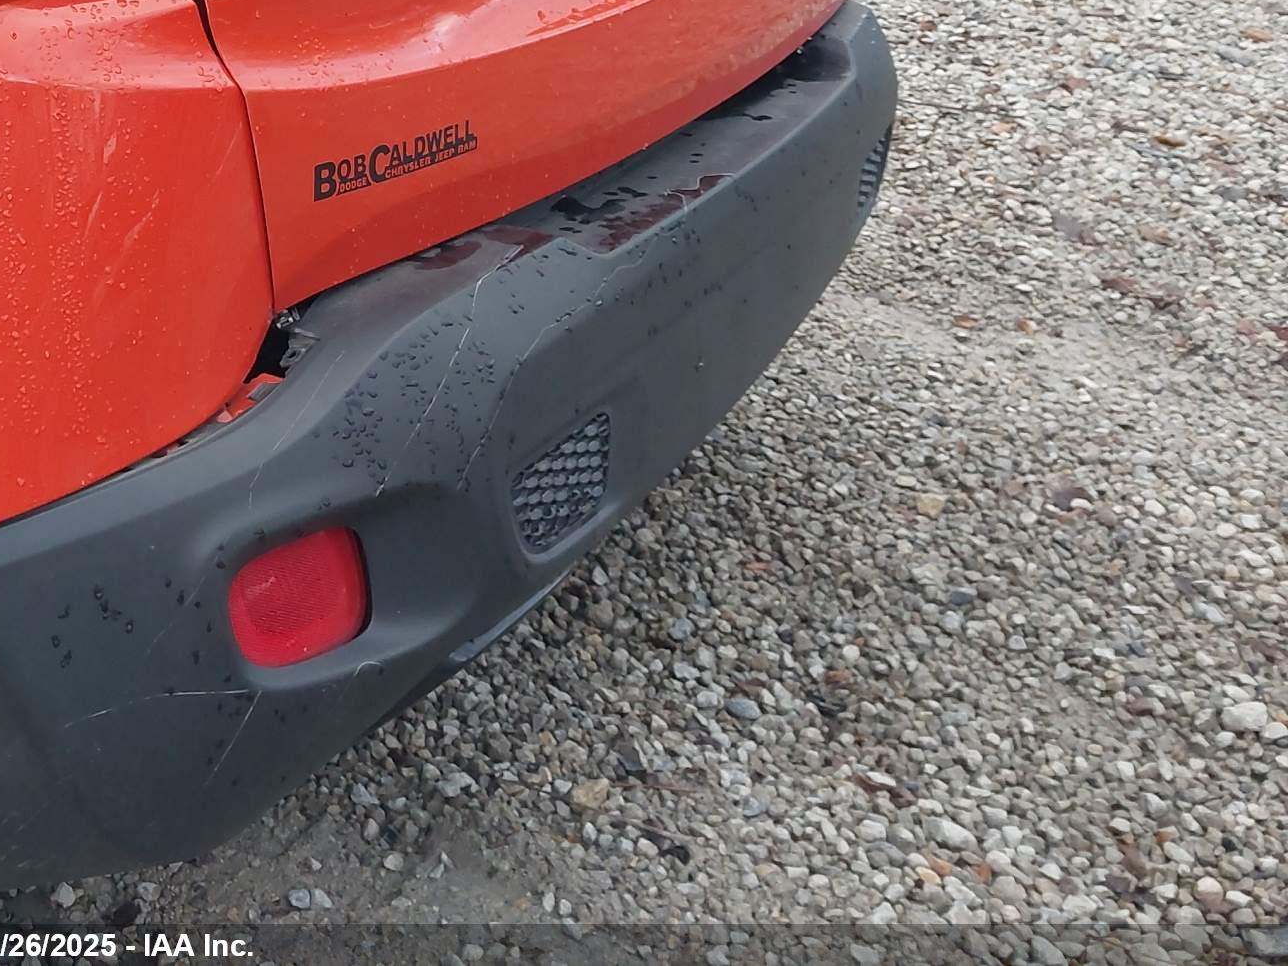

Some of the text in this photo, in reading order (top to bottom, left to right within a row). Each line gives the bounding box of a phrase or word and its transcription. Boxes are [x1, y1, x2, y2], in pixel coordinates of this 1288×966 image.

[313, 120, 476, 203] BOB CALDWELL
[338, 139, 477, 194] DODGE CHRYSLER JEEP RAM
